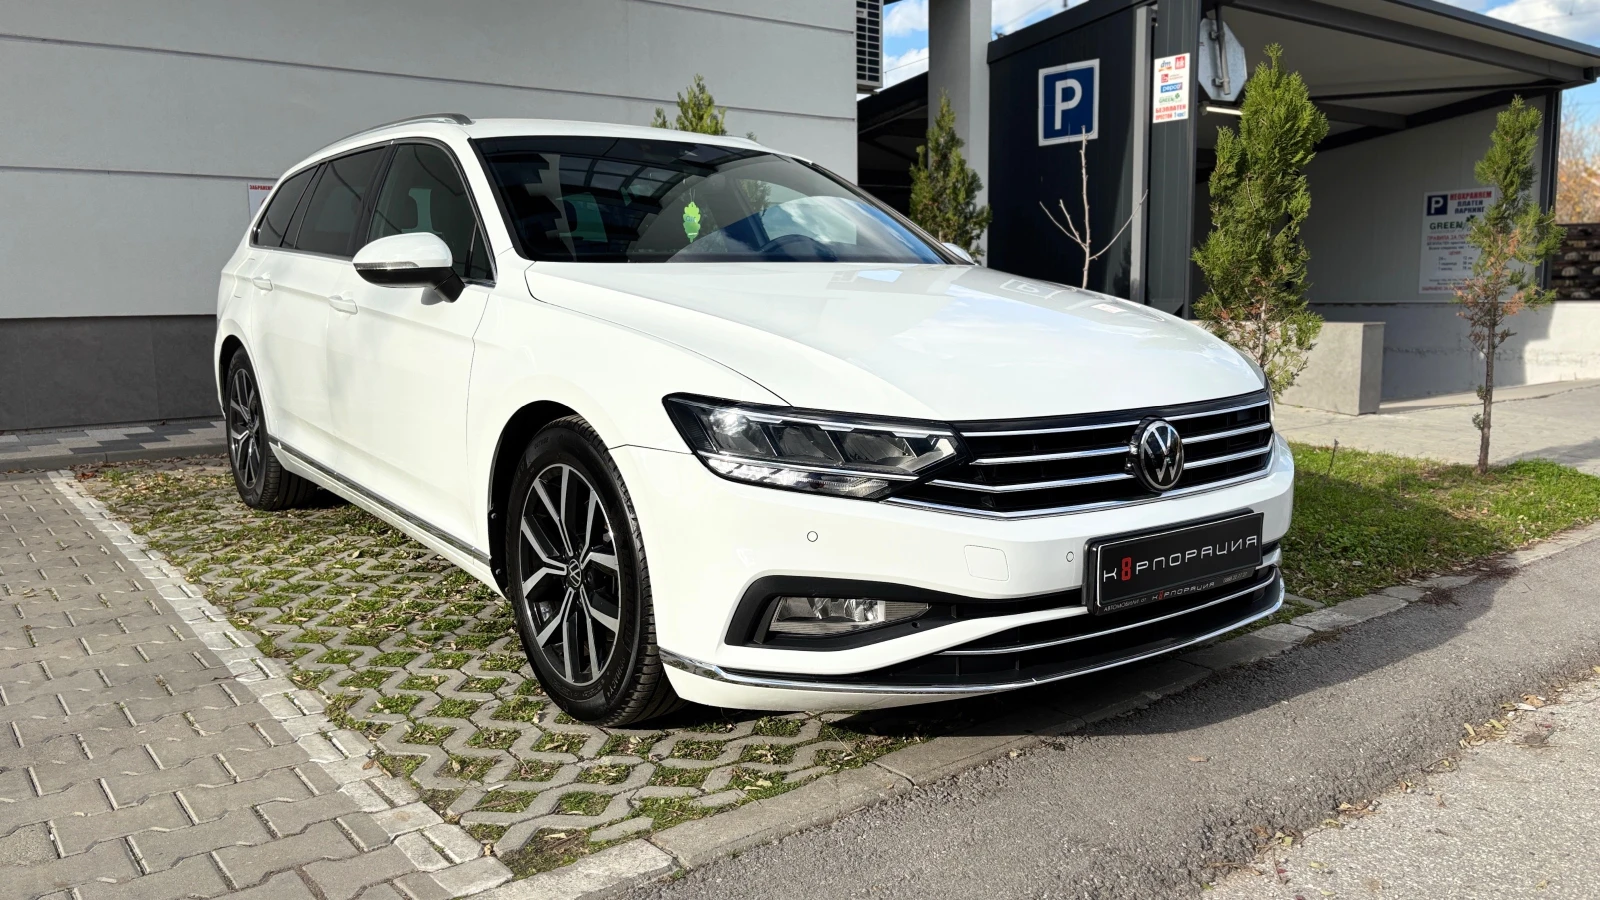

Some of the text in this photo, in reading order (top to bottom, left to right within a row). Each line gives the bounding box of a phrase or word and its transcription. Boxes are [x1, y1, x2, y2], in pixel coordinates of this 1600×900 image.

[1054, 78, 1082, 130] P
[1155, 104, 1186, 113] БЕЗПЛАТЕН
[1431, 196, 1444, 214] P
[1457, 199, 1483, 207] ПЛАТЕН
[1454, 206, 1485, 214] ПАРКИНГ
[1429, 221, 1463, 230] GREEN
